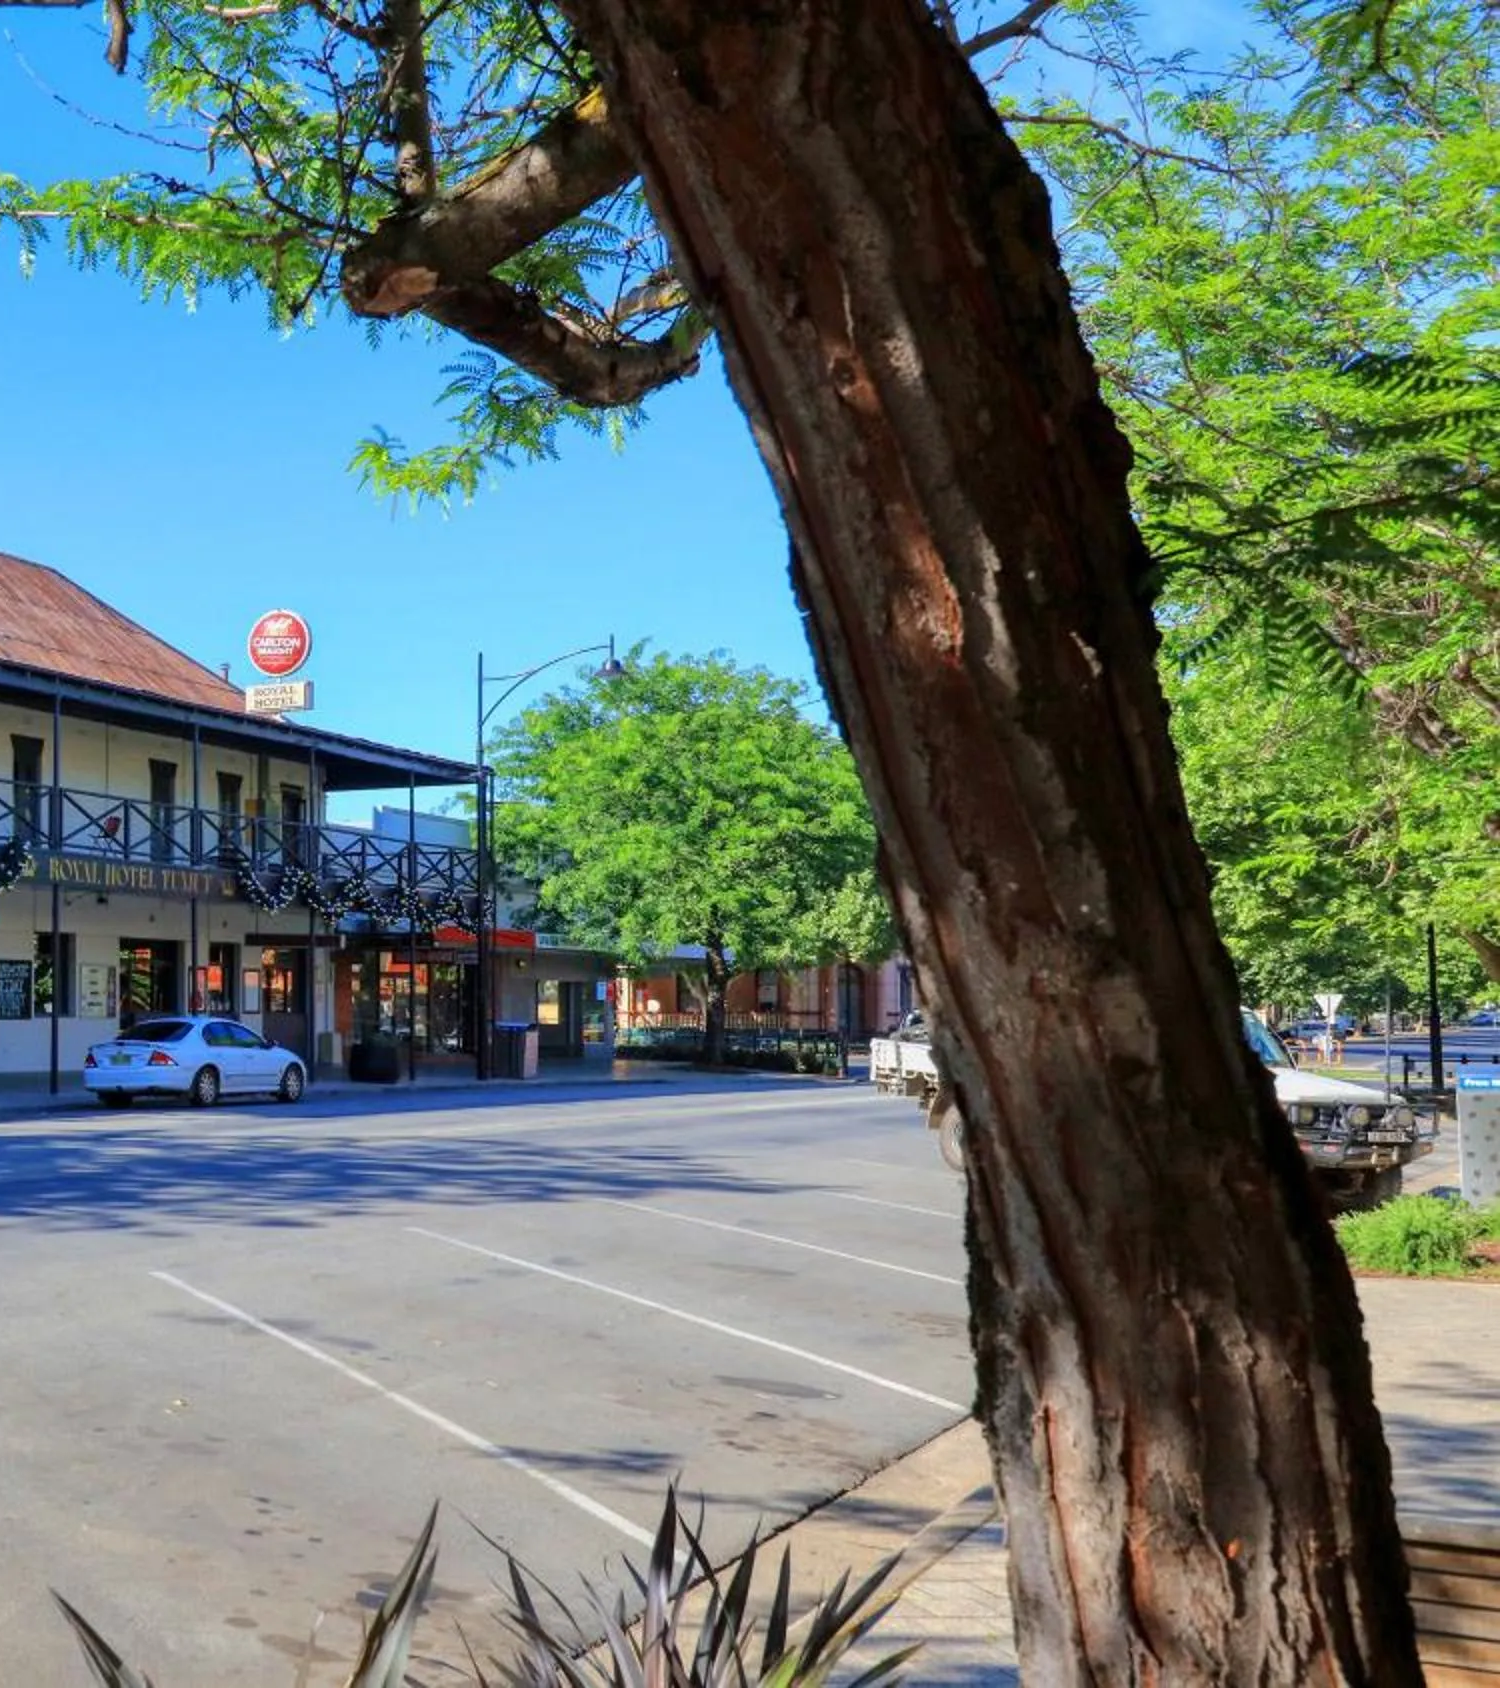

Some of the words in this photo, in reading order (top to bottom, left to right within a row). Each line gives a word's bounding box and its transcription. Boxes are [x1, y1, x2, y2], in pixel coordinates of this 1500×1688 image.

[253, 685, 297, 697] ROYAL
[253, 696, 297, 708] HOTEL
[49, 857, 101, 885] ROYAL
[105, 863, 156, 889] HOTEL
[161, 869, 213, 894] TUMUT
